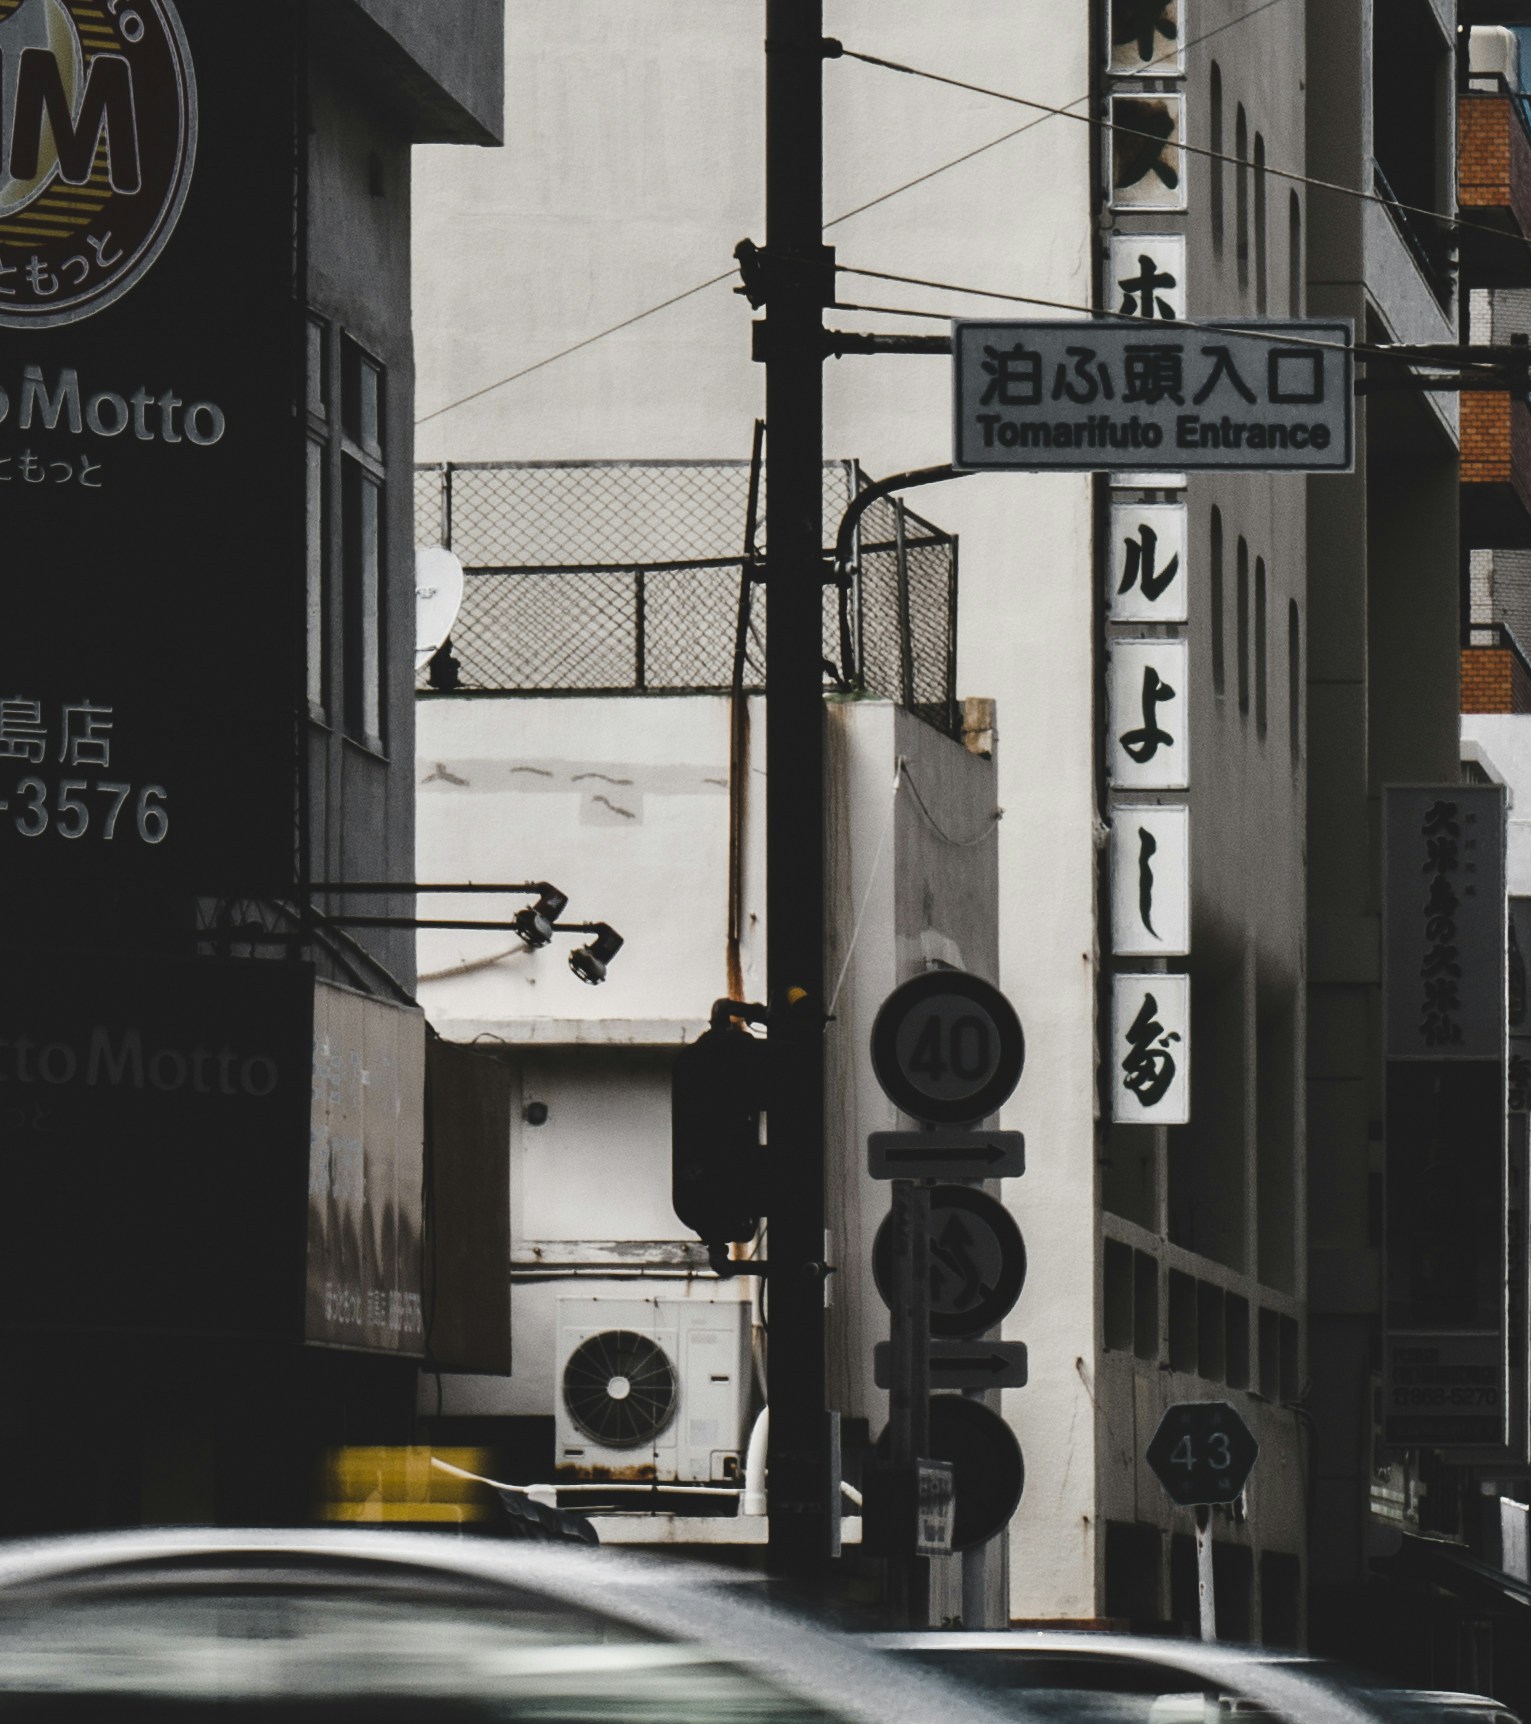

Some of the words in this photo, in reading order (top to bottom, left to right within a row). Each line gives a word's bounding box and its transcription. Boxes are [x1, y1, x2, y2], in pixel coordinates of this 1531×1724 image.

[0, 364, 226, 446] Motto
[979, 343, 1325, 406] 泊ふ頭入口
[976, 414, 1163, 449] Tomarifuto
[1176, 415, 1331, 449] Entrance
[907, 1014, 991, 1083] 40
[1169, 1432, 1231, 1471] 43
